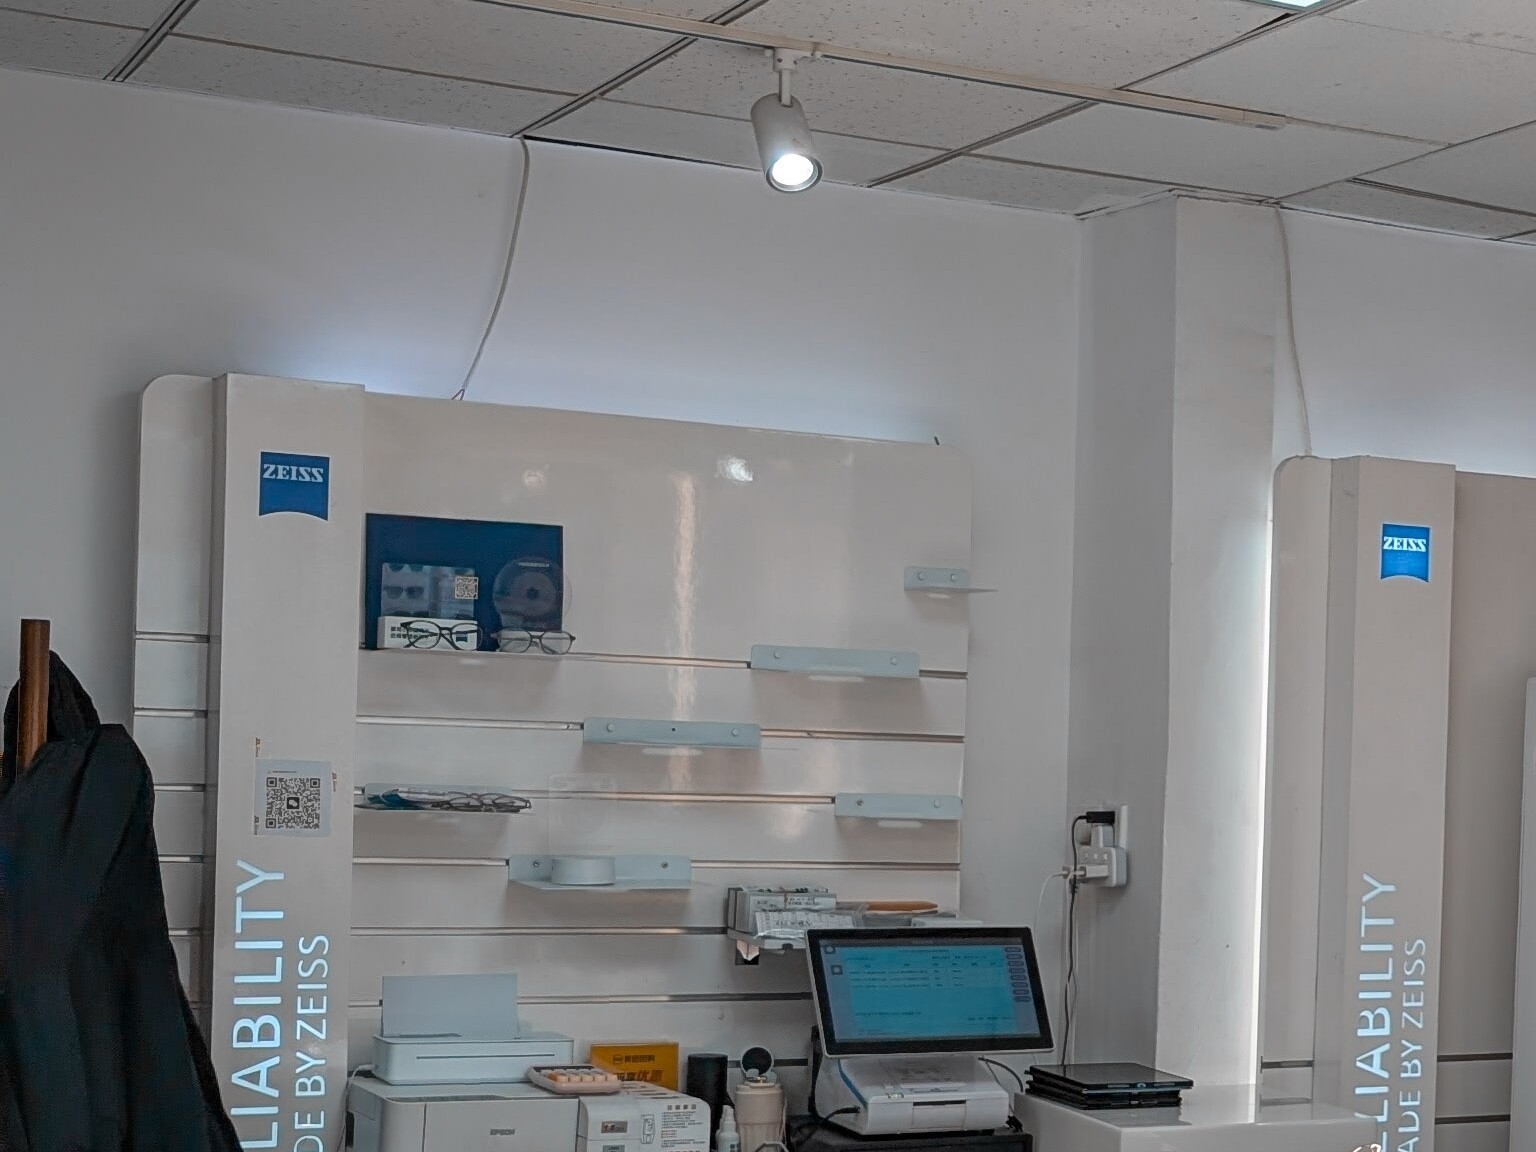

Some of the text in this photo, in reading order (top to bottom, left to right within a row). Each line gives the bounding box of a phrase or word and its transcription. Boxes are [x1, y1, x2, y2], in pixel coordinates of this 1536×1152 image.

[263, 463, 324, 483] ZEISS
[1383, 536, 1427, 553] ZEISS
[296, 935, 329, 1040] ZEISS
[1401, 938, 1426, 1029] ZEISS
[295, 1051, 326, 1097] BY
[1400, 1039, 1422, 1077] BY
